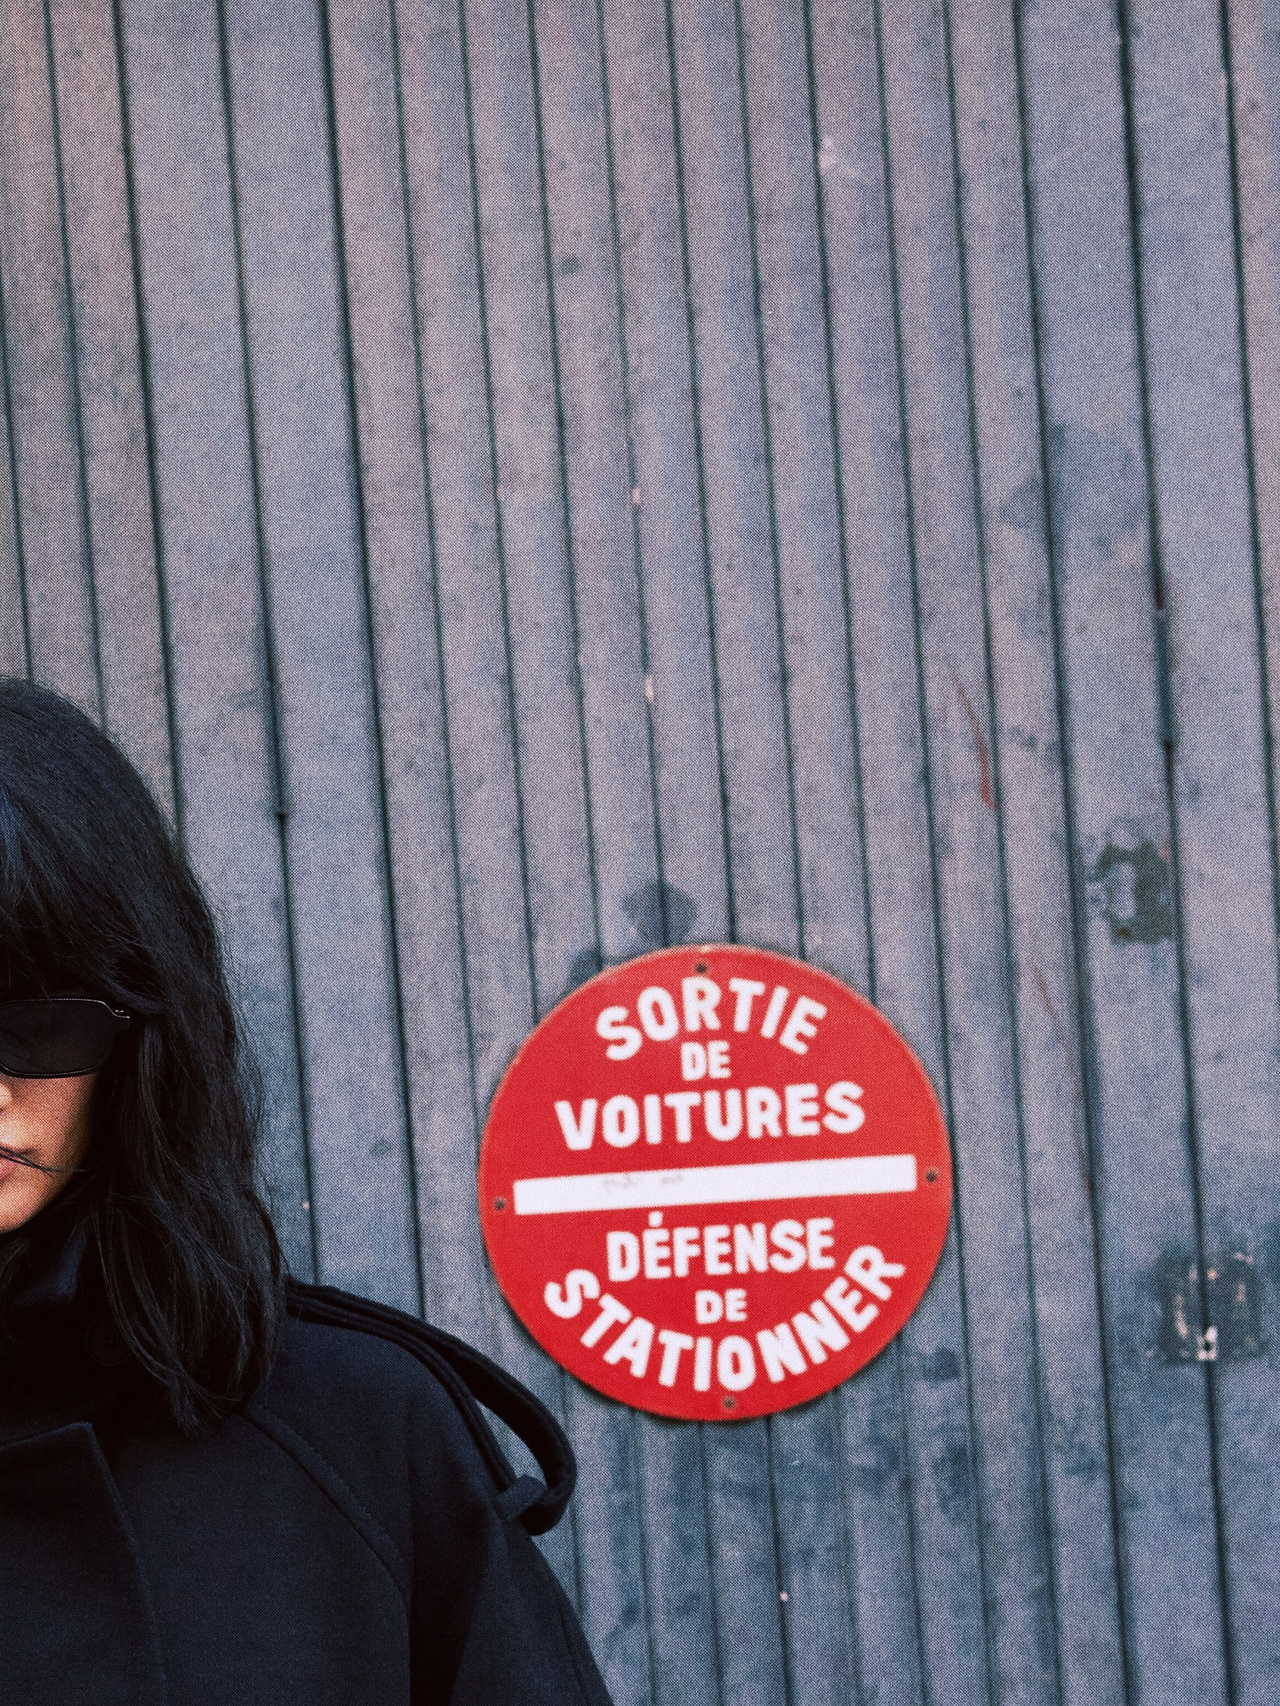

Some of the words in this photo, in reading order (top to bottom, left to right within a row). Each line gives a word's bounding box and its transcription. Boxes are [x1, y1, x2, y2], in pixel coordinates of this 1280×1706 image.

[595, 975, 827, 1061] SORTIE
[680, 1040, 731, 1081] DE
[554, 1080, 866, 1151] VOITURES
[606, 1210, 836, 1282] DÉFENSE
[543, 1244, 907, 1392] STATIONNER
[695, 1288, 748, 1324] DE
